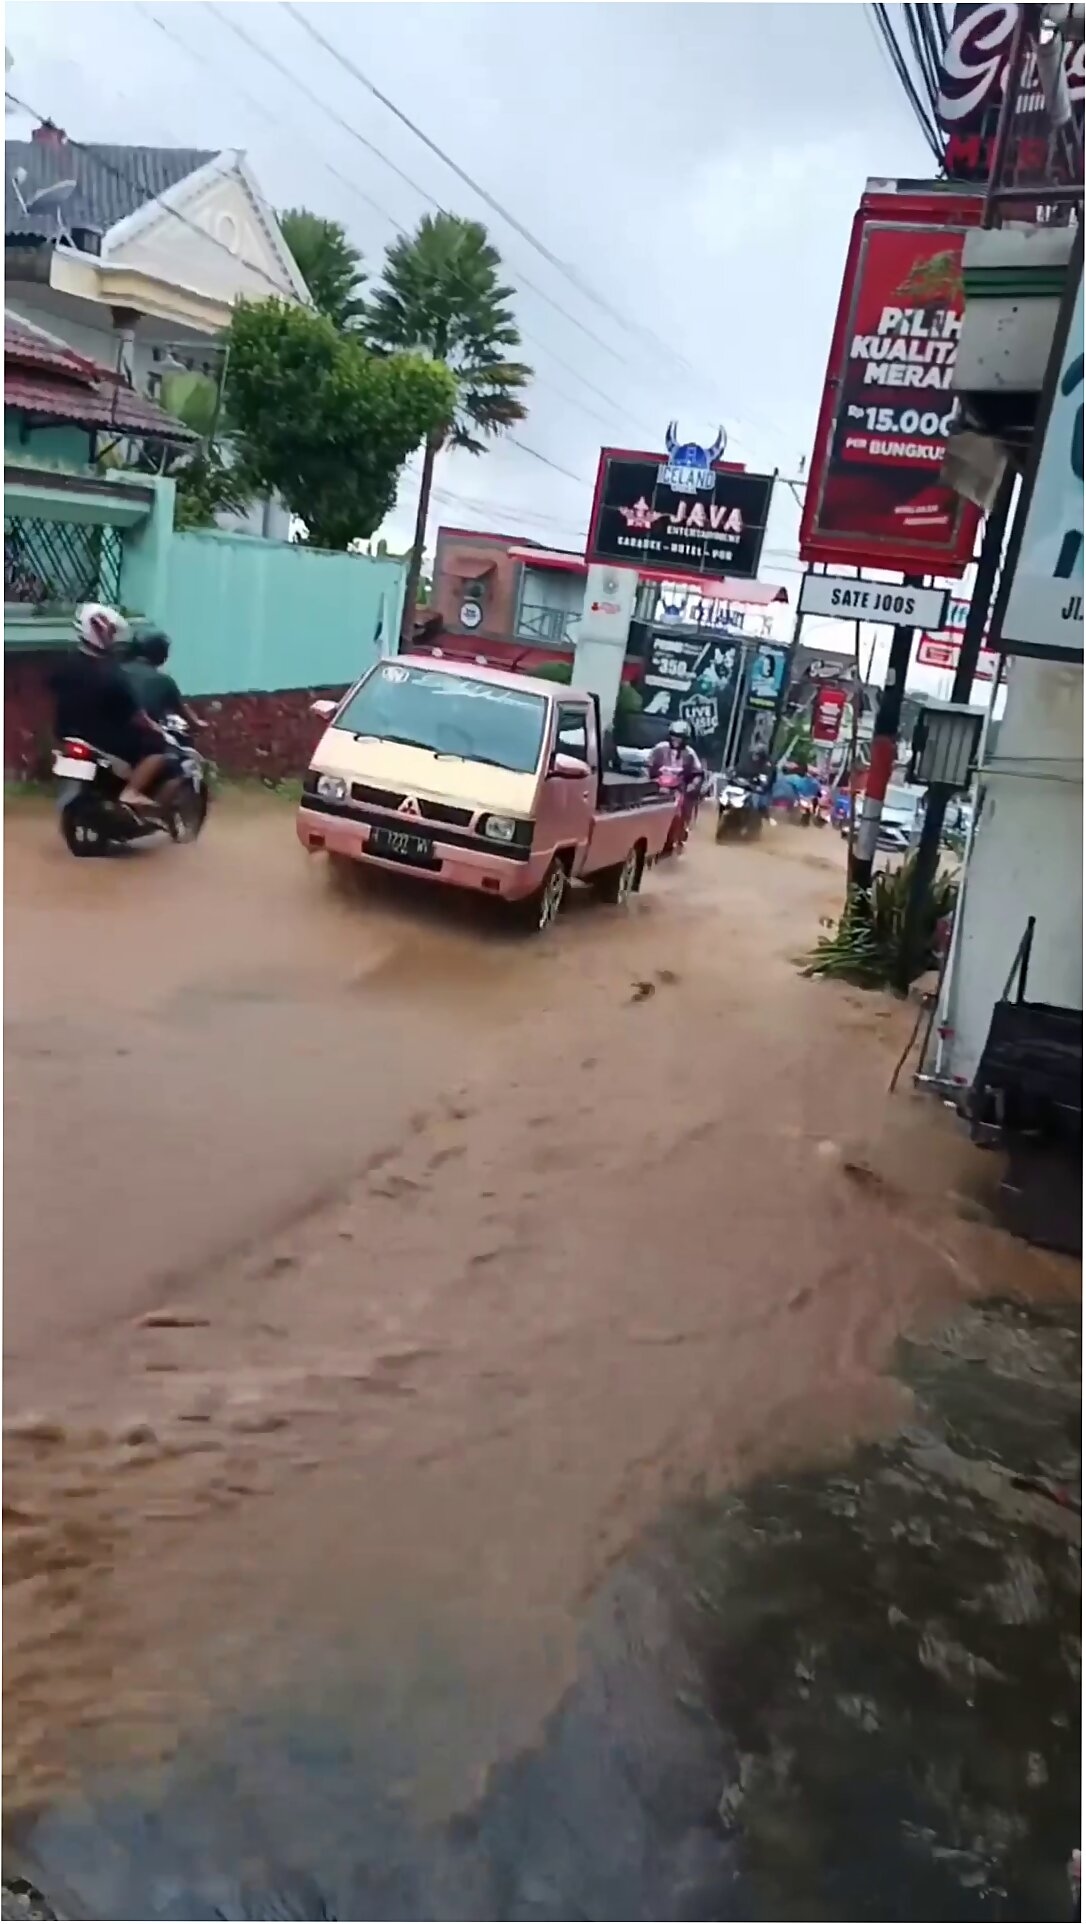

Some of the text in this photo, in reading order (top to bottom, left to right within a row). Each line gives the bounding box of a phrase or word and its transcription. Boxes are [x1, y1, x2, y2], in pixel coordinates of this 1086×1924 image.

[877, 306, 963, 339] PILIH
[669, 500, 743, 533] JAVA
[617, 536, 662, 551] KARAOKE
[671, 543, 702, 556] HOTEL
[831, 588, 916, 614] SATE JOOS
[685, 705, 711, 718] LIVE
